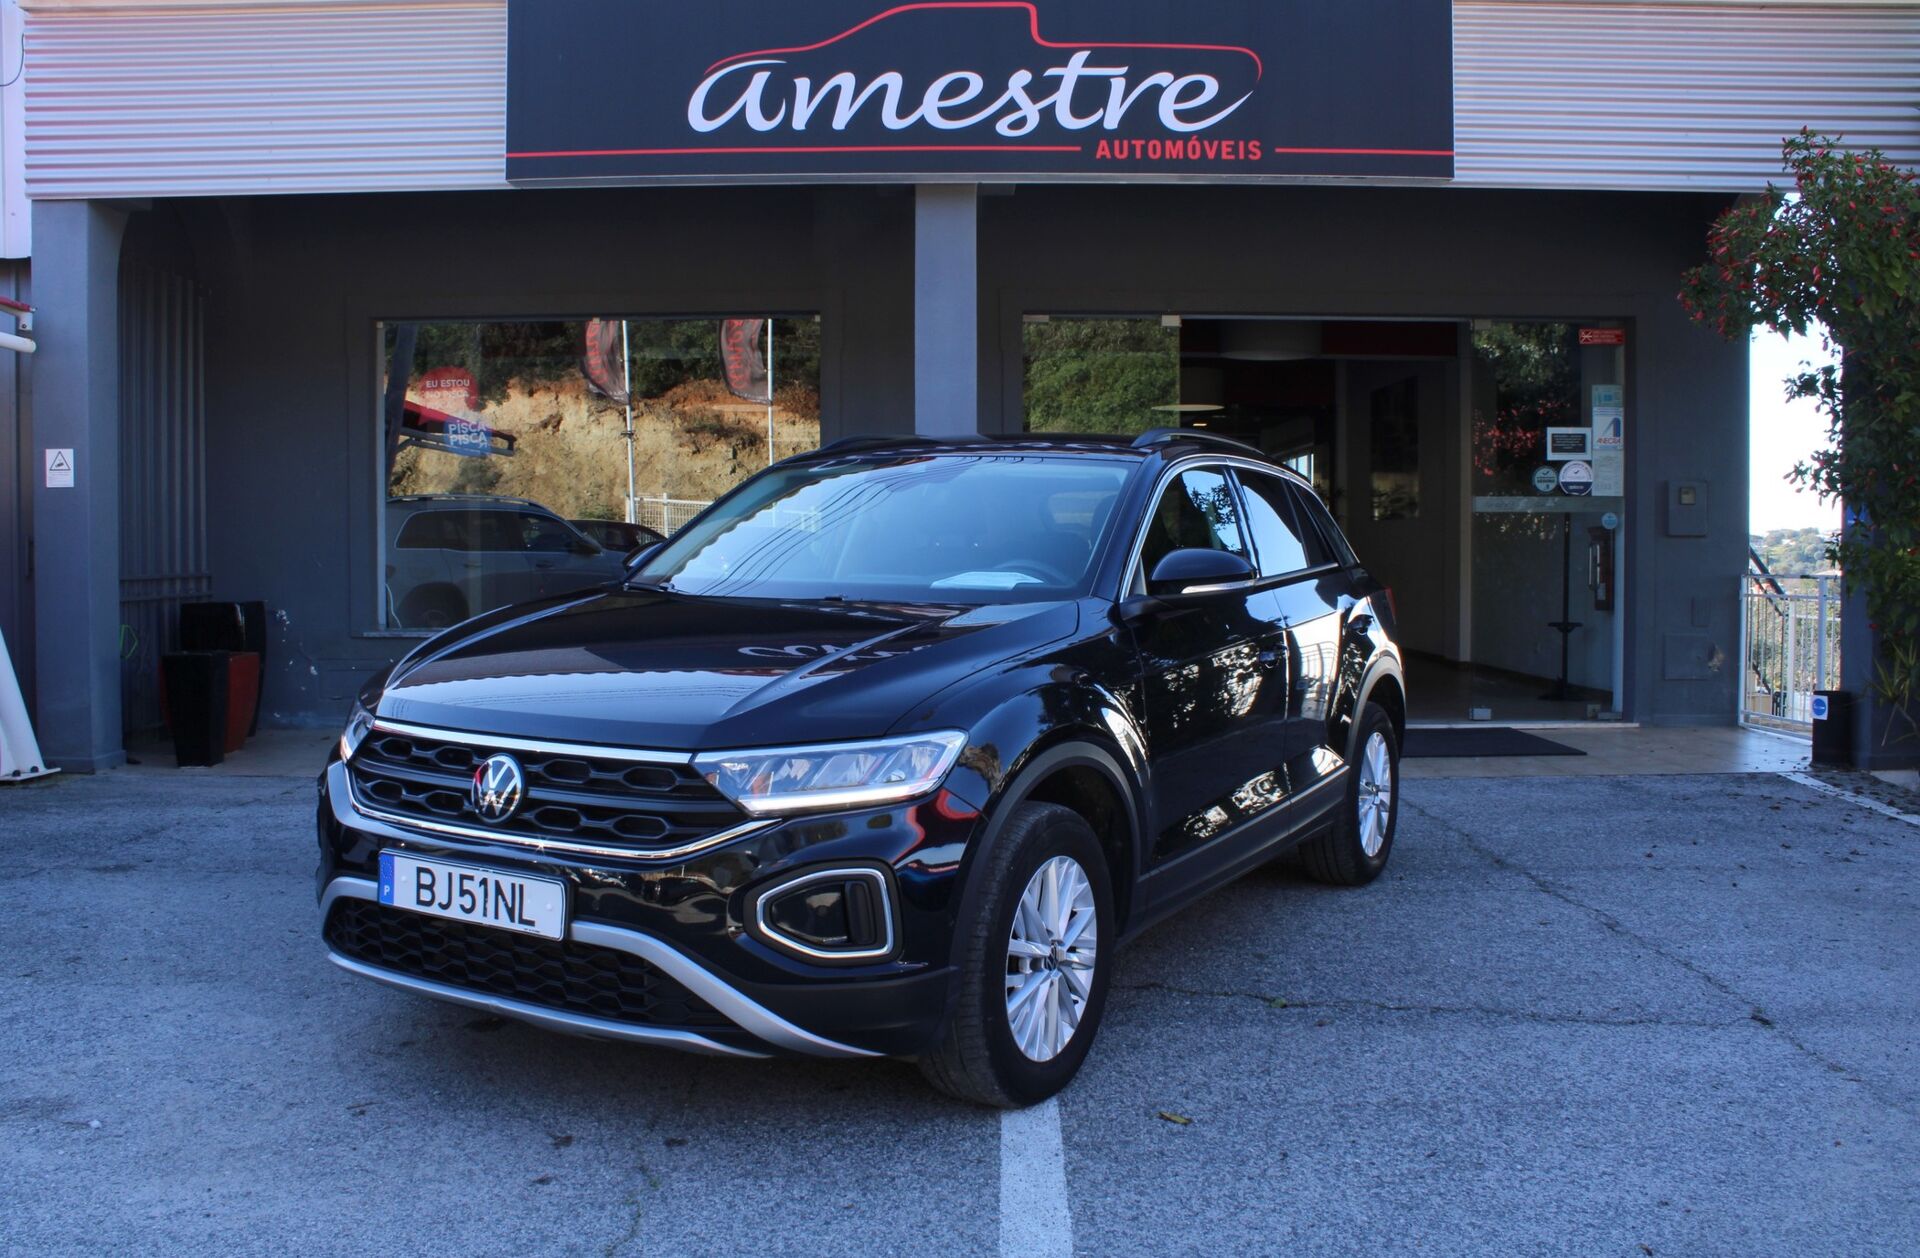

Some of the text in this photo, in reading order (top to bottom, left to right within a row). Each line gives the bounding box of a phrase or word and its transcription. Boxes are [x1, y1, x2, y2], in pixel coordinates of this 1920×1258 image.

[687, 50, 1255, 137] amestre
[1095, 136, 1262, 160] AUTOMÓVEIS
[425, 379, 470, 388] EU ESTOU
[416, 866, 536, 927] BJ51NL
